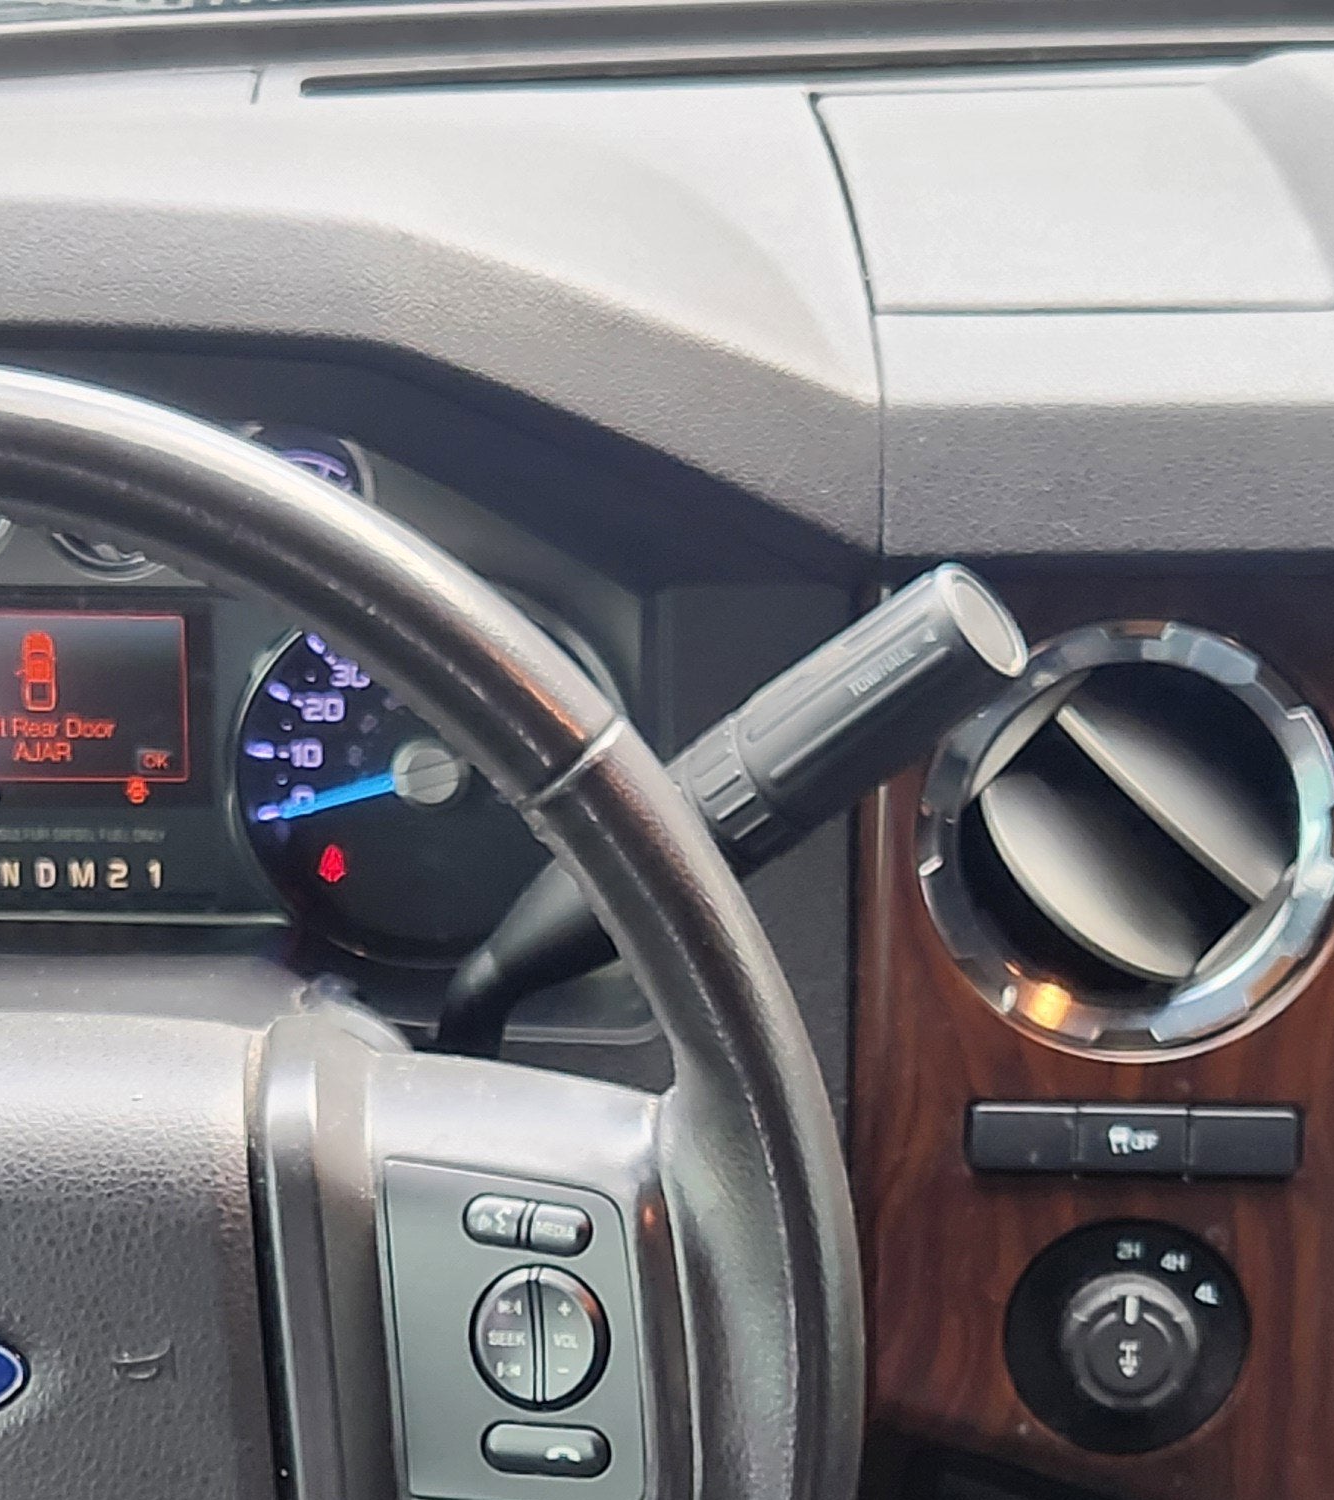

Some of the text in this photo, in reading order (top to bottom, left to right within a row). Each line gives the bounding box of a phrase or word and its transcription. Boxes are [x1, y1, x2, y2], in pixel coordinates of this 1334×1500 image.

[301, 692, 345, 722] 20
[13, 717, 60, 738] Rear
[67, 717, 117, 738] Door
[14, 742, 72, 762] AJAR
[143, 753, 168, 769] OK
[291, 739, 323, 767] 10
[0, 858, 20, 888] N
[35, 858, 57, 888] D
[69, 858, 95, 889] M
[107, 859, 130, 889] 2
[148, 858, 163, 888] 1
[536, 1221, 575, 1240] MEDIA
[1116, 1241, 1140, 1260] 2H
[1160, 1252, 1188, 1272] 4H
[488, 1331, 526, 1347] SEEK
[553, 1333, 579, 1349] VOL
